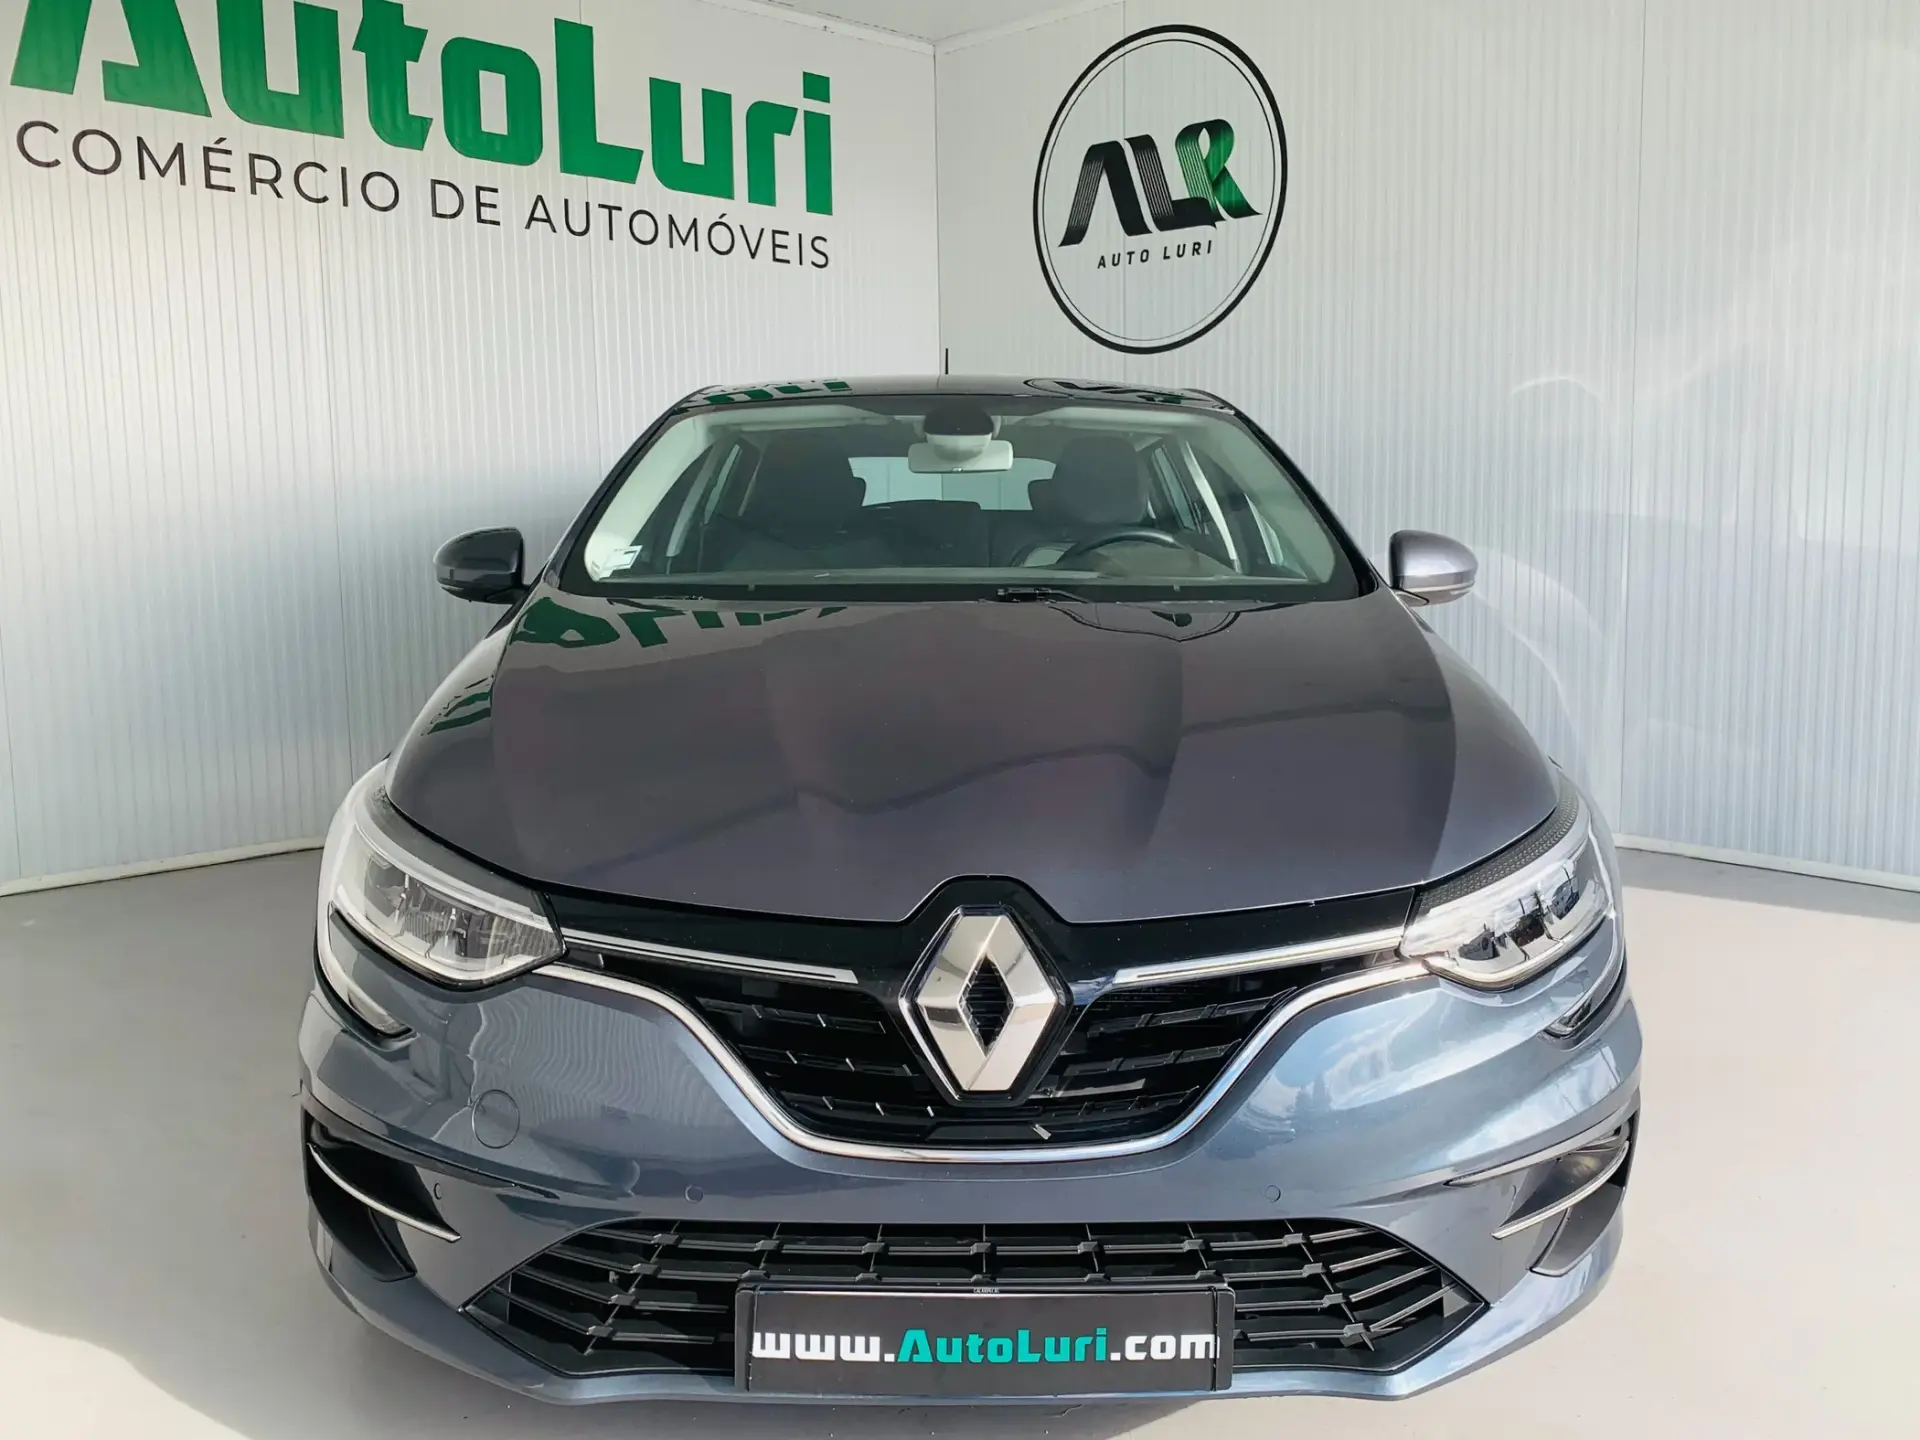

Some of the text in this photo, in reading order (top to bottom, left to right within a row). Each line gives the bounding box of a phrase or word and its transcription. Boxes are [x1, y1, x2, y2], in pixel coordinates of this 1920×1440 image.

[17, 121, 829, 269] COMÉRCIO DE AUTOMÓVEIS
[1097, 240, 1212, 269] AUTO LURI
[752, 1328, 1221, 1364] www.AutoLuri.com
